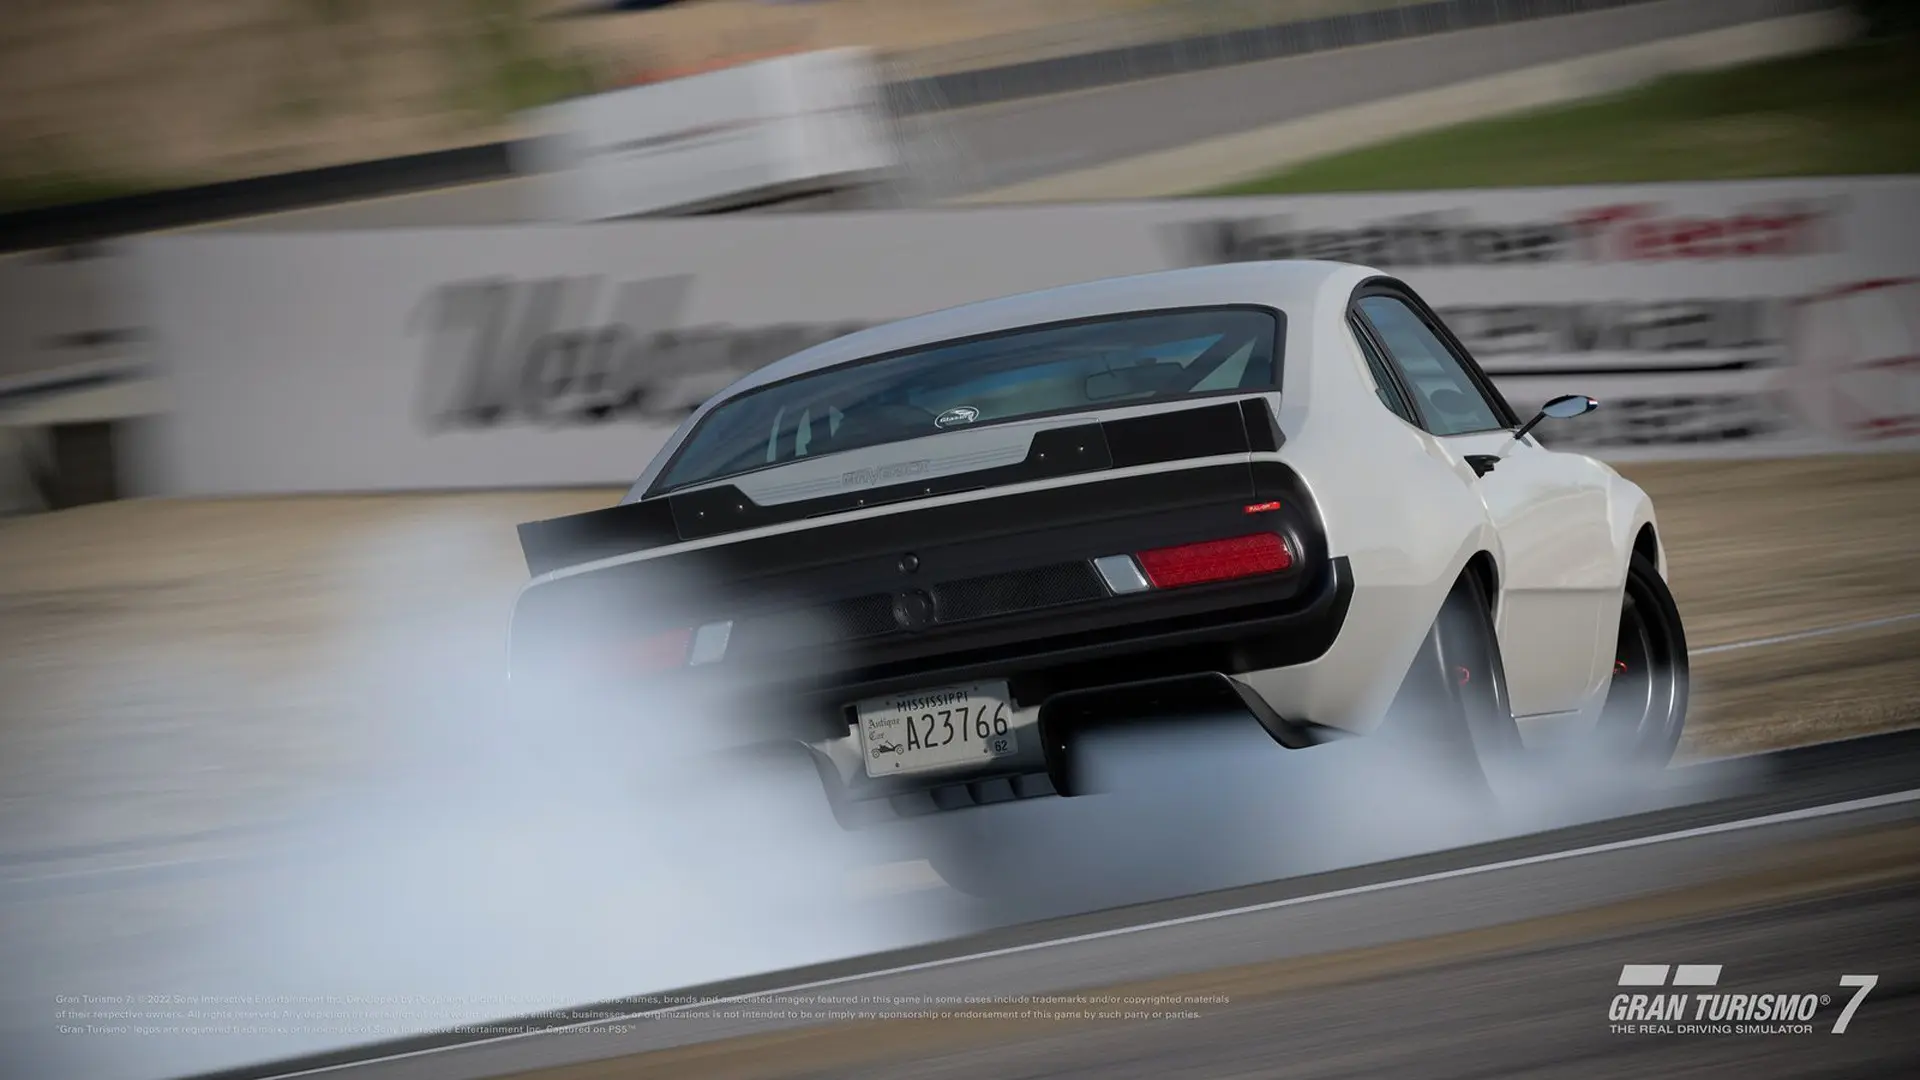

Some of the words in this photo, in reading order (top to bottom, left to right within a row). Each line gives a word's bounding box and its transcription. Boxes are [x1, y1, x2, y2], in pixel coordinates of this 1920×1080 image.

[897, 691, 969, 712] MISSISSIPPI
[868, 717, 901, 730] Antique
[906, 702, 1008, 751] A23766
[868, 731, 886, 741] Car
[994, 740, 1008, 752] 62
